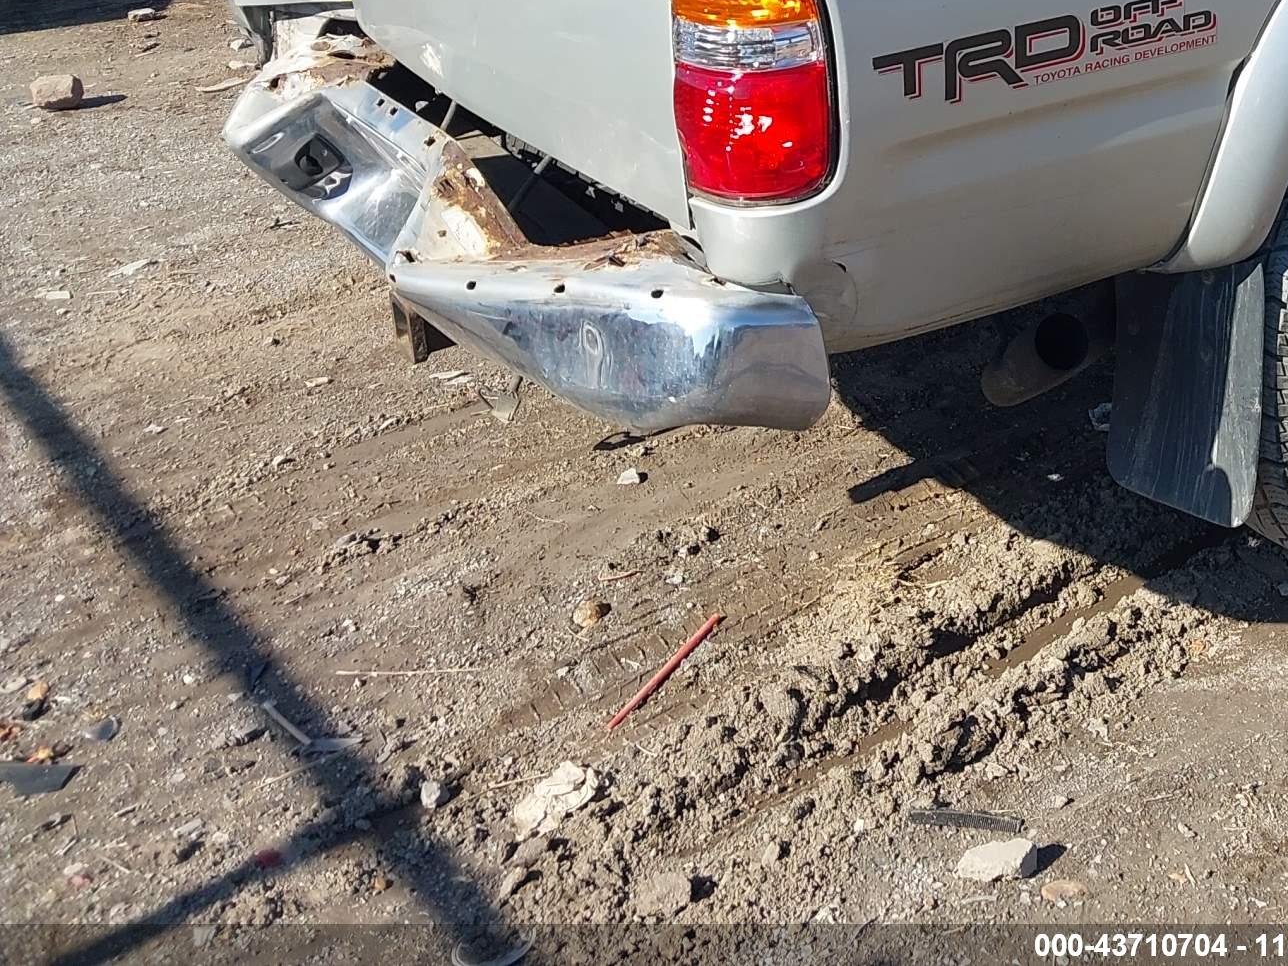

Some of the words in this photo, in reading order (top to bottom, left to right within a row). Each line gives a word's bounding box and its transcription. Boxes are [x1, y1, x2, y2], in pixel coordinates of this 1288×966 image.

[1090, 10, 1217, 54] ROAD
[872, 14, 1086, 103] TRD
[1034, 66, 1081, 85] TOYOTA
[1085, 54, 1130, 74] RACING
[1133, 35, 1217, 61] DEVELOPMENT
